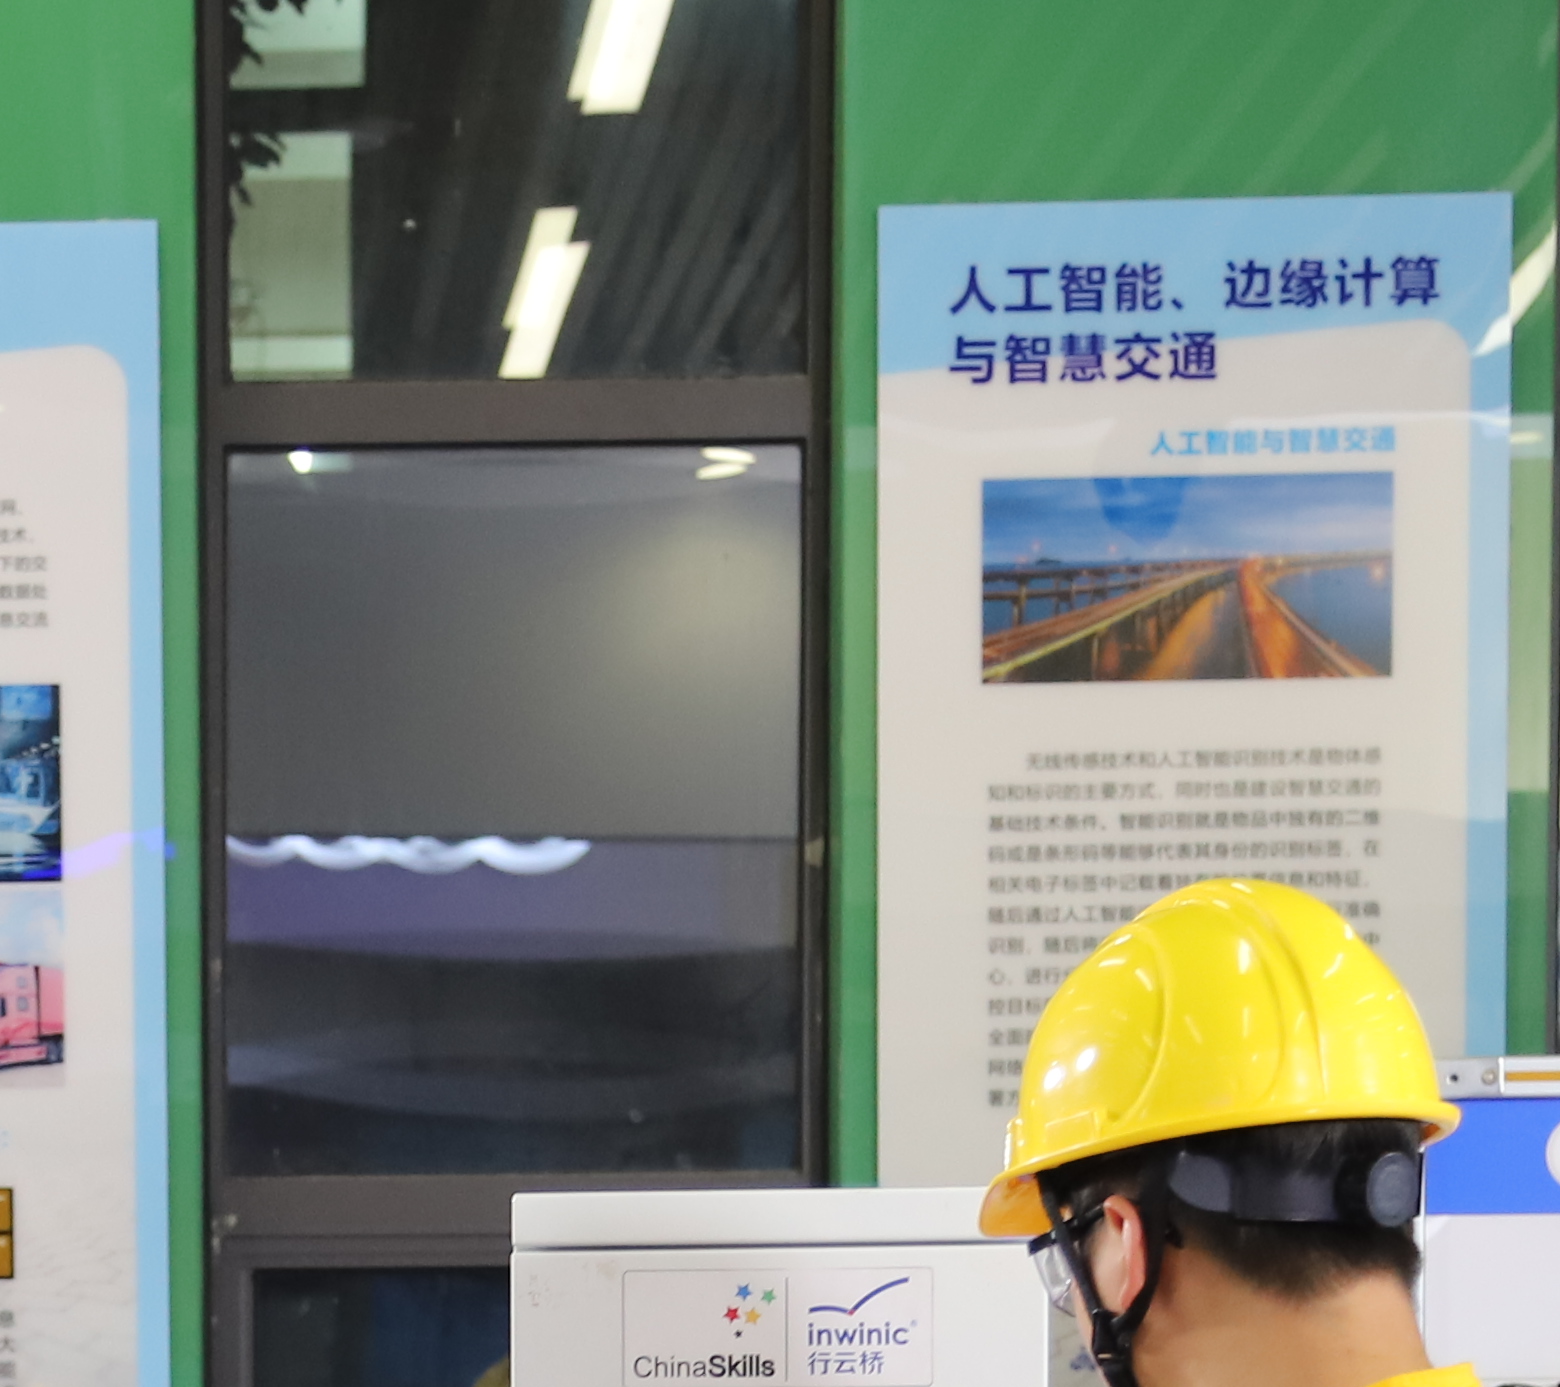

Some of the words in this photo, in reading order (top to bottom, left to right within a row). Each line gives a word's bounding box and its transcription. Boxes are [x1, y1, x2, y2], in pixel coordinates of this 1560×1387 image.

[950, 255, 1440, 315] 人工智能、边缘计算
[948, 331, 1219, 386] 与智慧交通
[1149, 426, 1397, 457] 人工智能与智慧交通
[807, 1322, 909, 1346] inwinic
[633, 1354, 776, 1378] ChinaSkills
[808, 1351, 884, 1375] 行云桥
